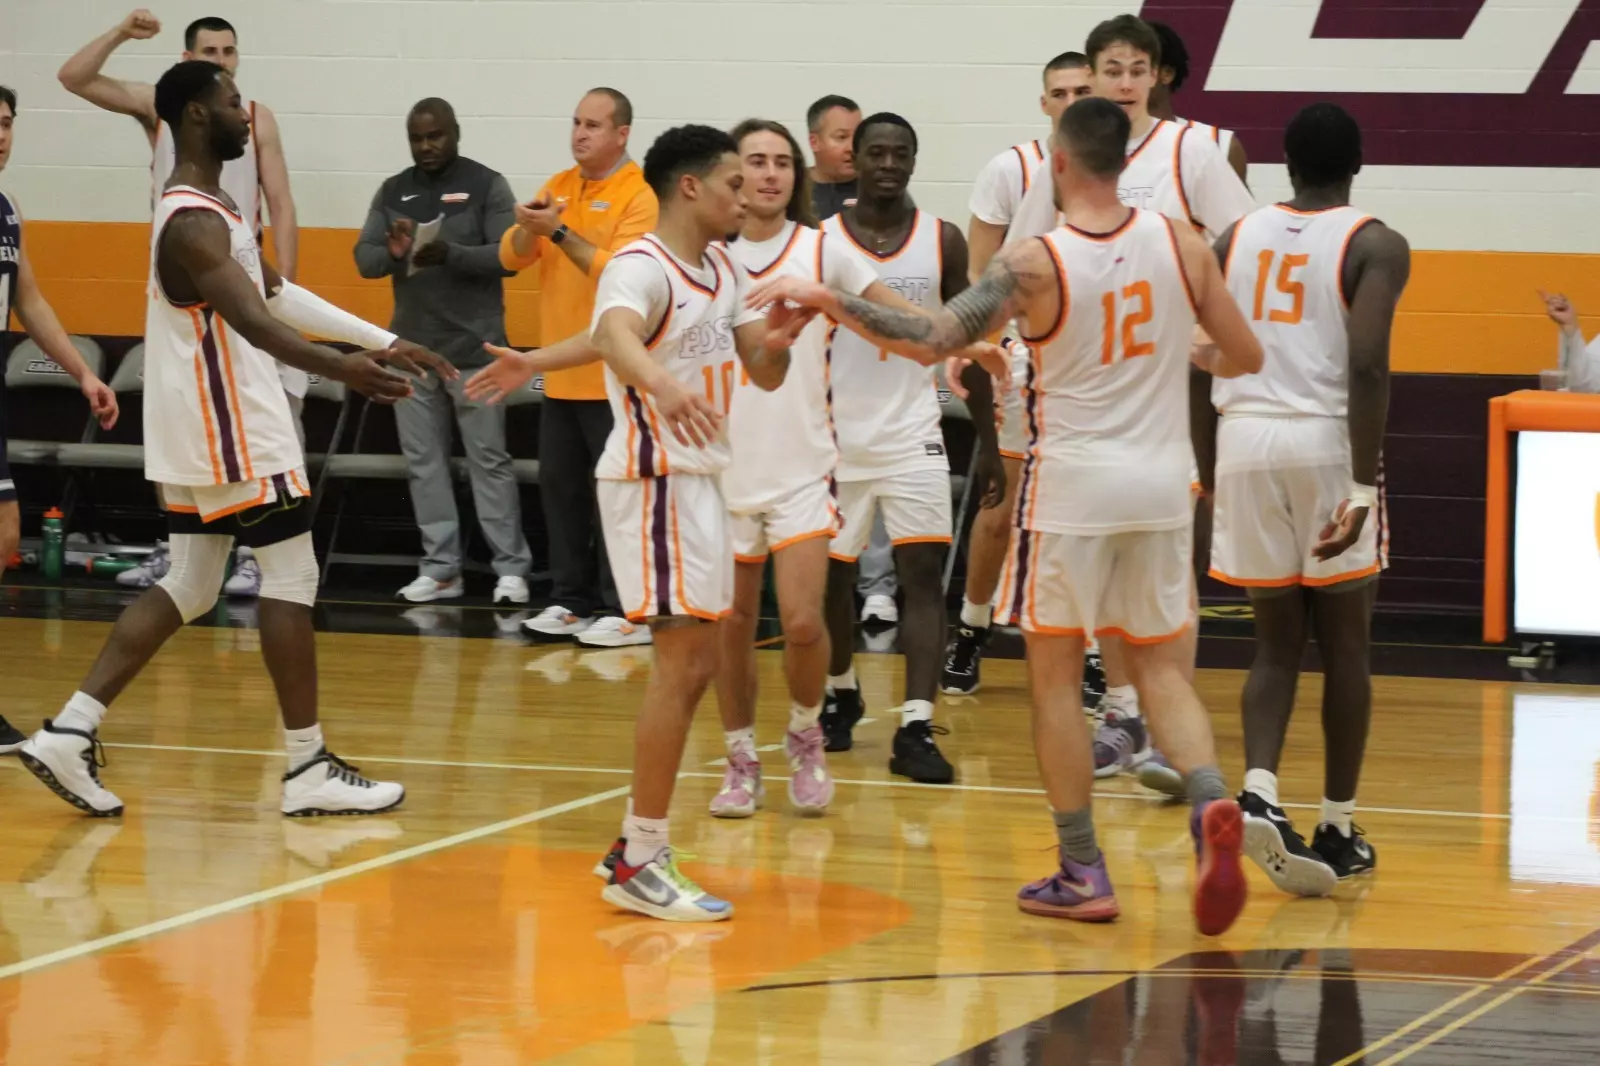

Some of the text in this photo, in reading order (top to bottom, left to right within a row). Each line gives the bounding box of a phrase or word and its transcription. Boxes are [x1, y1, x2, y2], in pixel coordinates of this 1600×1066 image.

[883, 277, 929, 306] ST
[1253, 249, 1310, 324] 15
[679, 316, 736, 359] POS
[1101, 280, 1155, 365] 12
